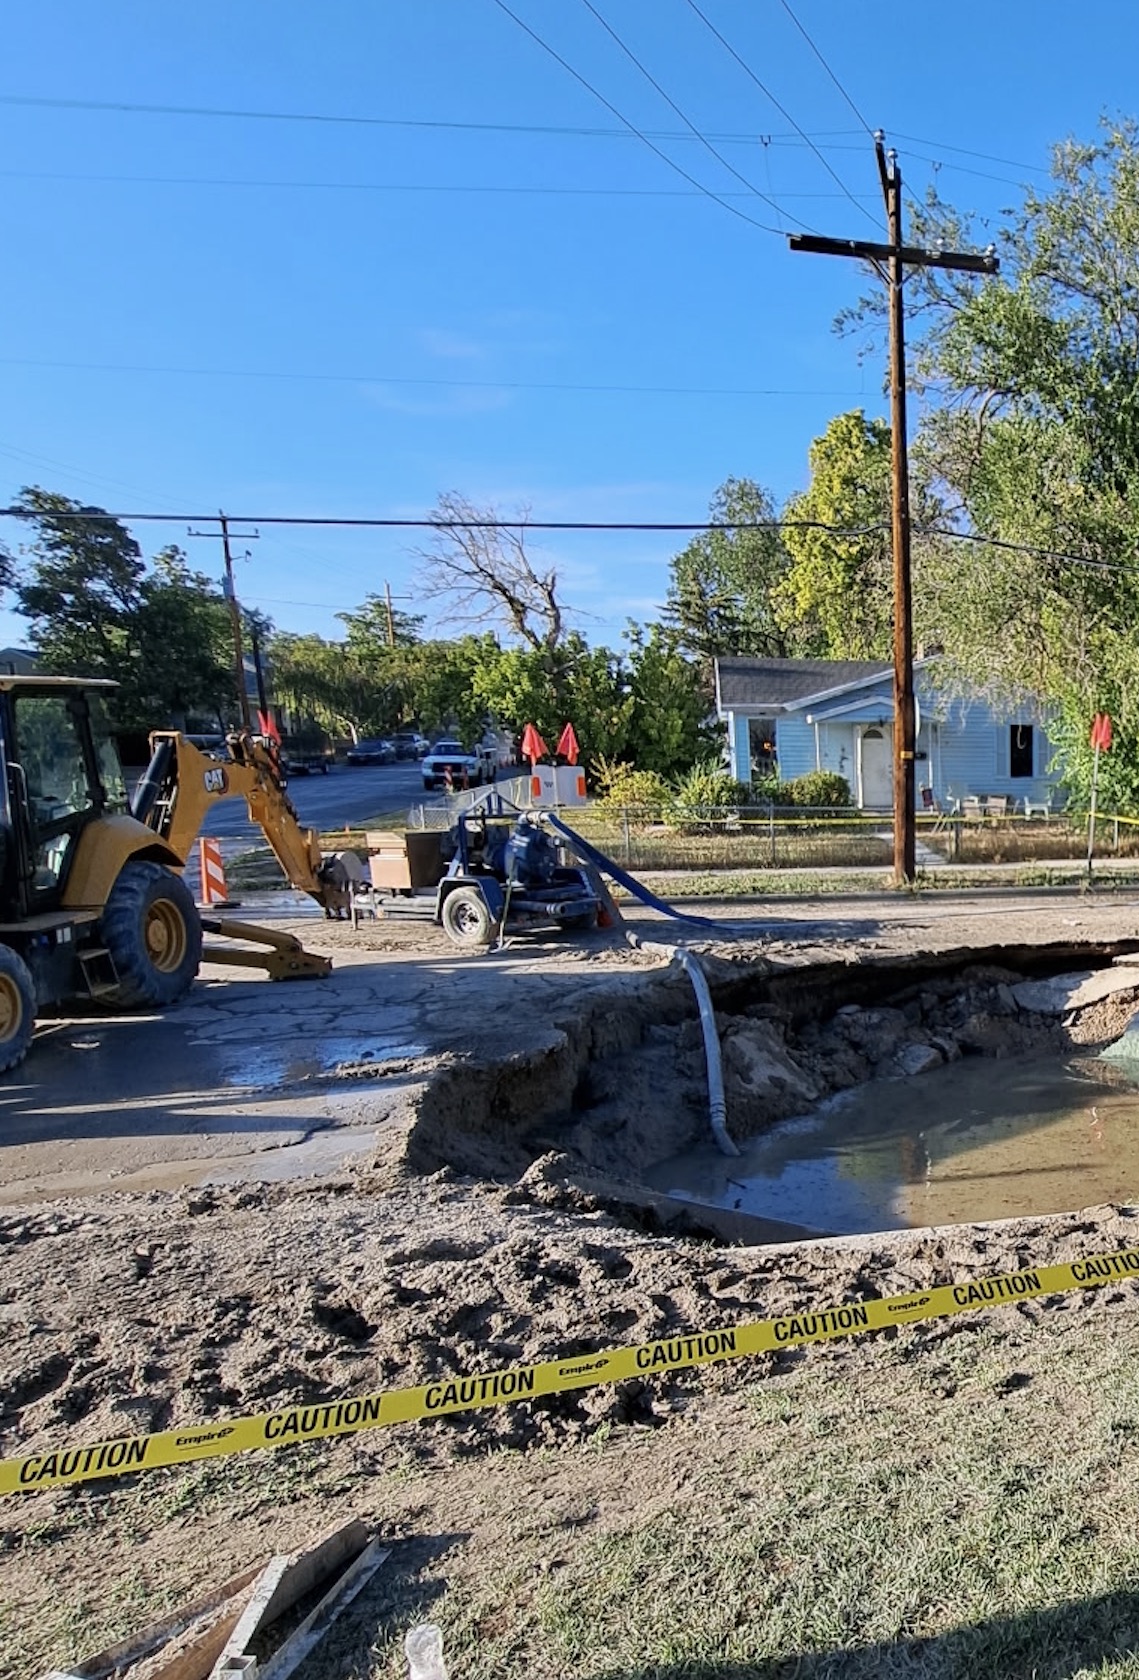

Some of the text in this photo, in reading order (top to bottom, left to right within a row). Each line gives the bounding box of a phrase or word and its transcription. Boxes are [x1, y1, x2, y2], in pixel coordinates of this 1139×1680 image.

[952, 1273, 1042, 1306] CAUTION
[772, 1306, 869, 1342] CAUTION
[636, 1331, 737, 1369] CAUTION
[425, 1369, 535, 1410] CAUTION
[264, 1396, 382, 1440] CAUTION
[19, 1437, 150, 1484] CAUTION
